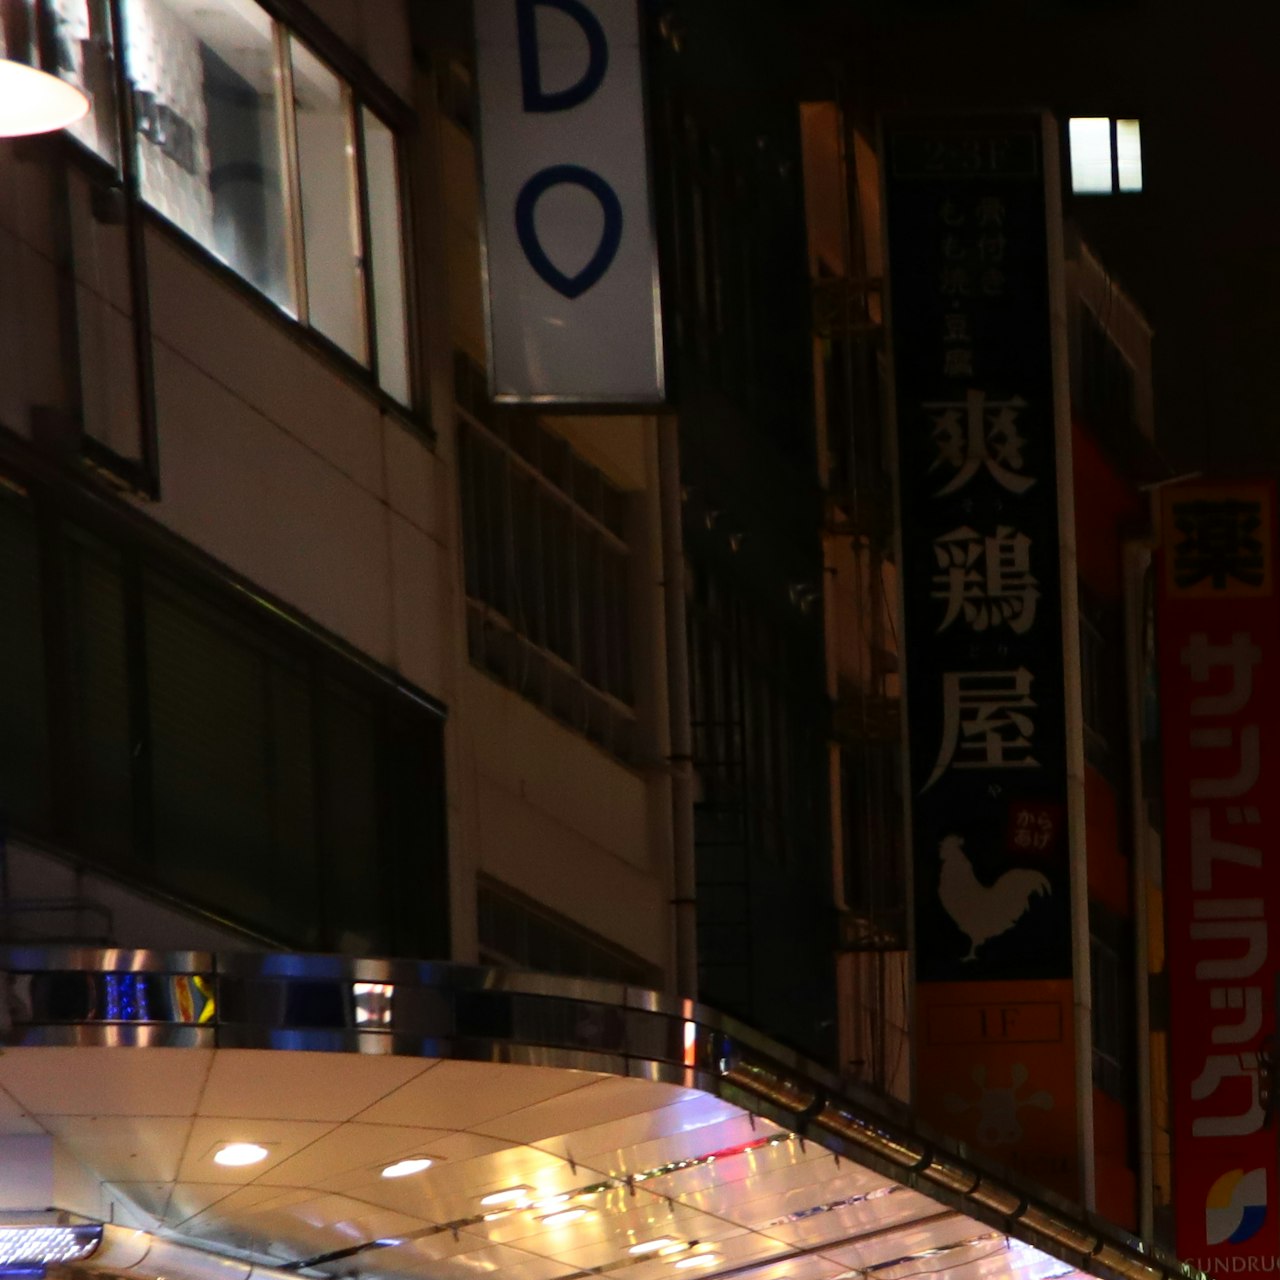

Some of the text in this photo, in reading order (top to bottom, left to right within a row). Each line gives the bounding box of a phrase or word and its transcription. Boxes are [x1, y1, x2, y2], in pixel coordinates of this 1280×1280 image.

[919, 385, 1044, 798] 爽鶏屋
[1172, 502, 1265, 590] 薬
[1178, 630, 1269, 1139] サンドラッグ
[1184, 1256, 1280, 1275] SUNDRU
